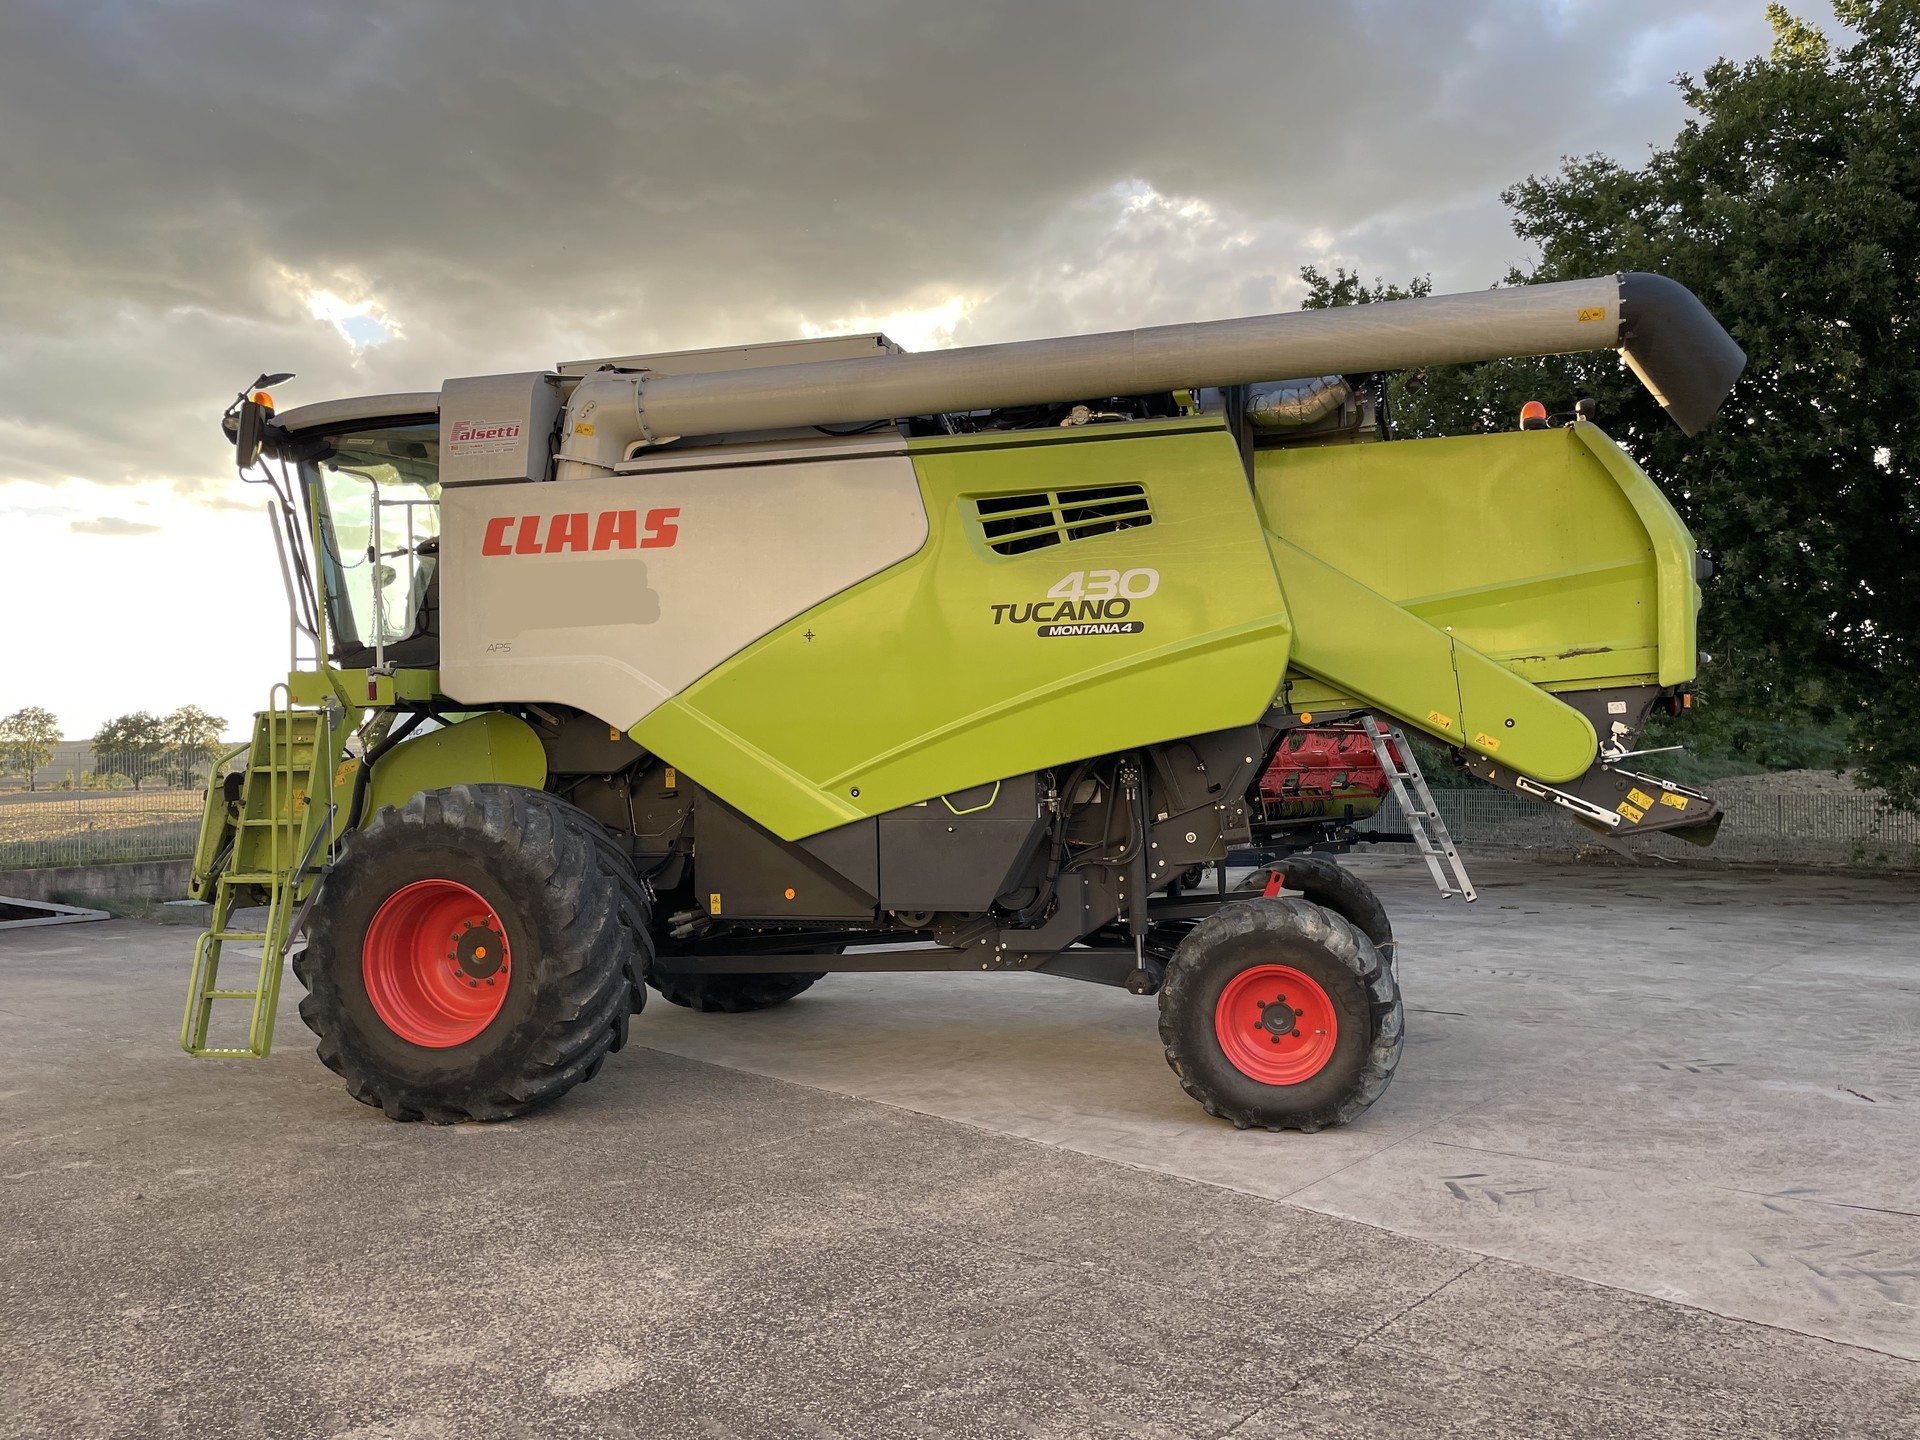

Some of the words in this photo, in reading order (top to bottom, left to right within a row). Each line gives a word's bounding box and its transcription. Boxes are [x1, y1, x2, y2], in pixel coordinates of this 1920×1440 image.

[482, 508, 681, 556] CLAAS
[1047, 568, 1160, 601] 430
[990, 598, 1131, 624] TUCANO
[486, 643, 512, 653] APS
